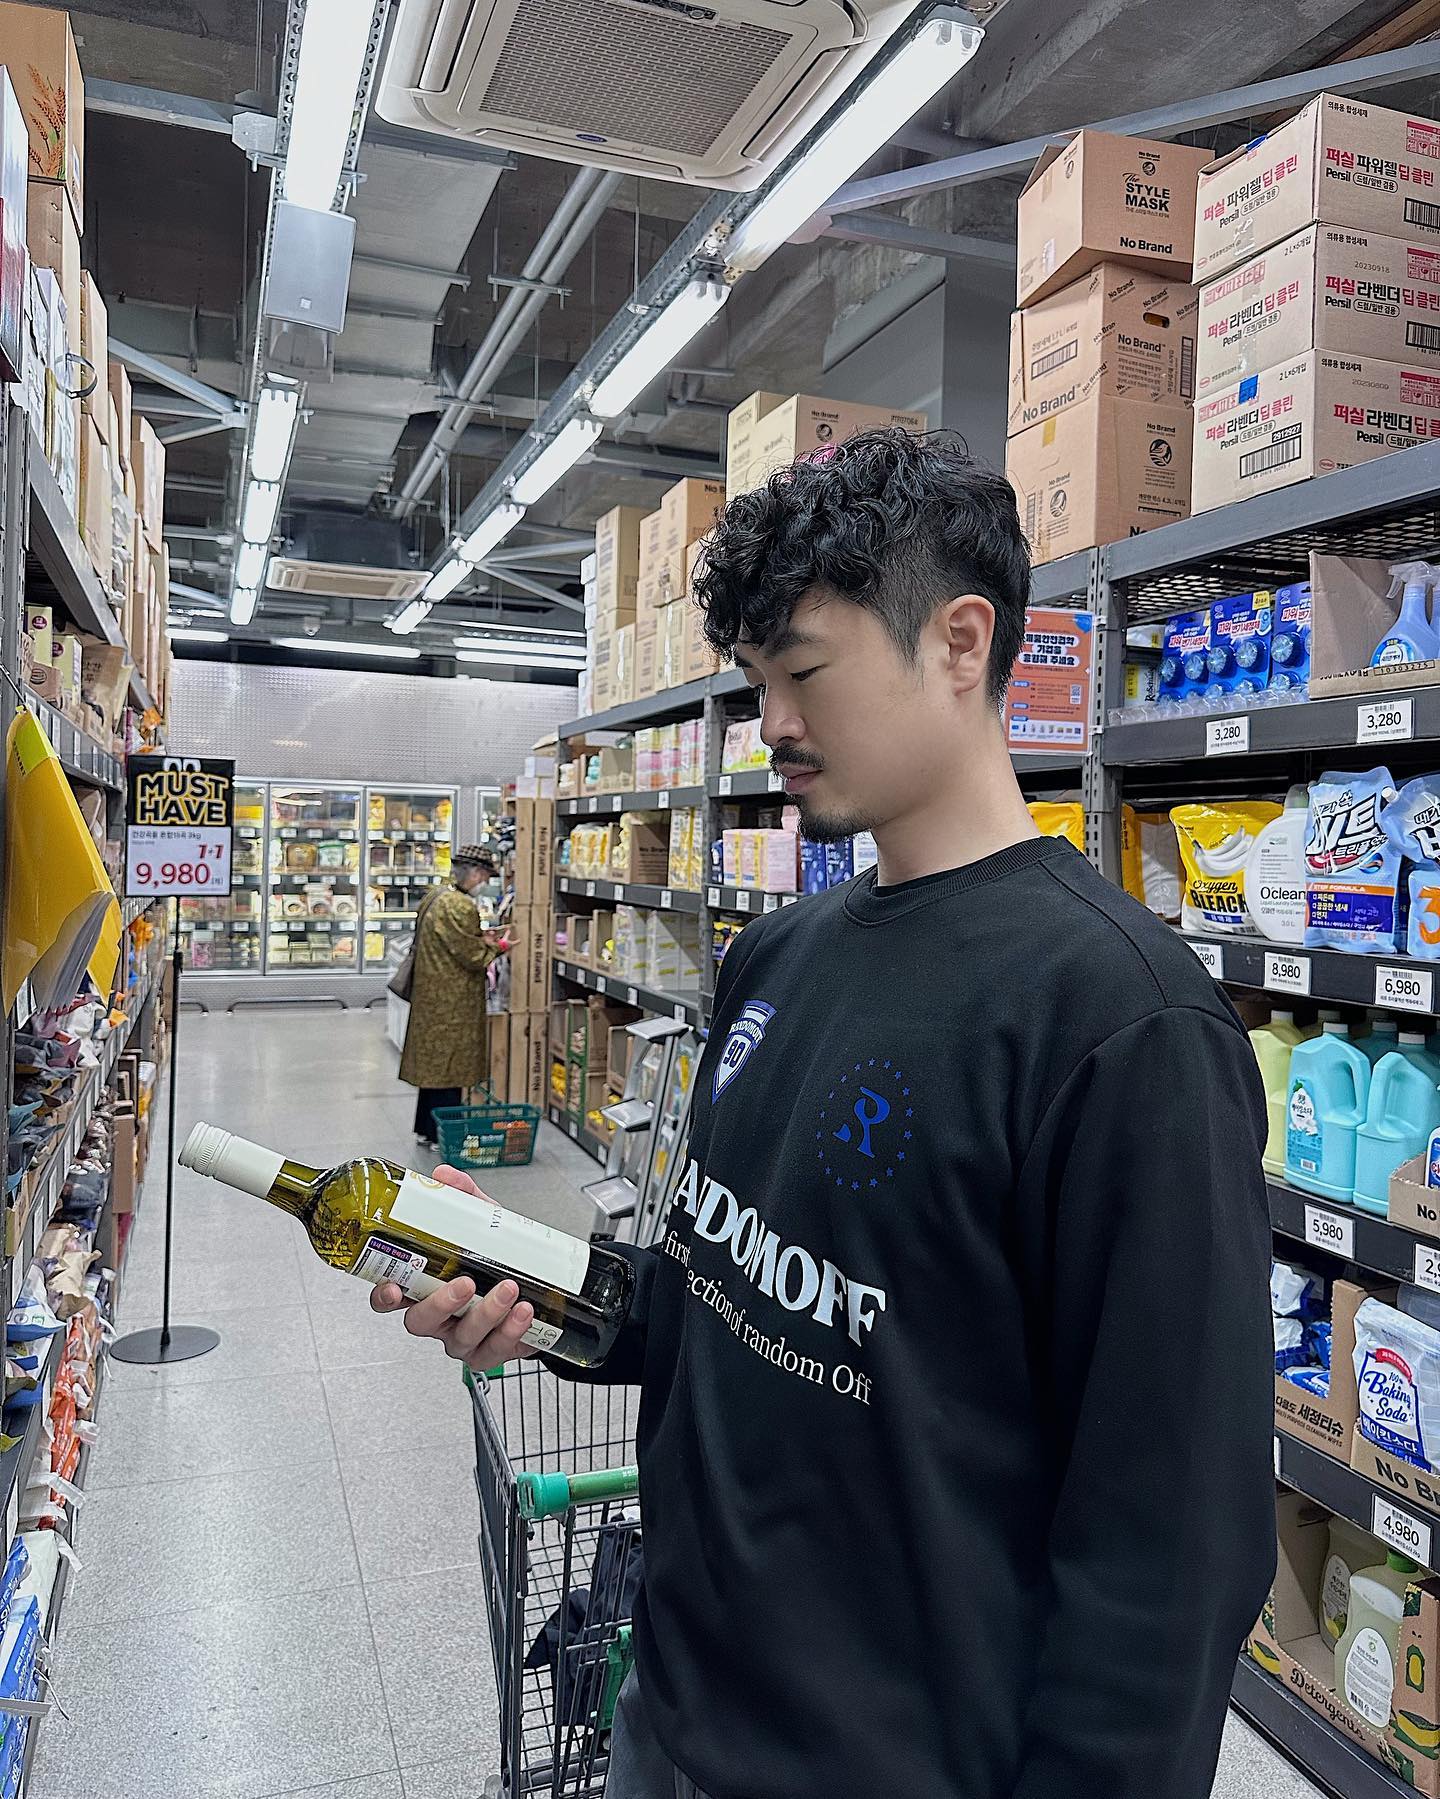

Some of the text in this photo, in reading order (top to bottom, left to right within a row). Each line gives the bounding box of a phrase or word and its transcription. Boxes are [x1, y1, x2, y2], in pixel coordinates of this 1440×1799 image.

[1328, 101, 1345, 113] 의류용
[1326, 147, 1434, 187] 퍼실 파워젤 딥 클린
[1326, 167, 1351, 182] Persil
[1122, 172, 1141, 184] The
[1126, 183, 1170, 199] STYLE
[1204, 154, 1298, 221] 퍼실 파워젤 딥 클린
[1126, 194, 1170, 212] MASK
[1219, 209, 1240, 228] Persil
[1120, 237, 1172, 254] No Brand
[1354, 261, 1390, 274] 20230918
[1108, 280, 1134, 299] No Brand
[1326, 276, 1440, 312] 퍼실 라벤더 딥 클린
[1142, 290, 1168, 308] No Brand
[1325, 296, 1352, 309] Persil
[1208, 281, 1299, 338] 퍼실 라벤더 딥 클린
[1118, 334, 1162, 352] No Brand
[1223, 330, 1242, 347] Persil
[1022, 386, 1076, 424] No Brand
[1206, 394, 1294, 441] 퍼실 라벤더 딥 클린
[1334, 404, 1427, 436] 퍼실 라벤더 딥
[1147, 422, 1176, 434] No Brand
[1356, 430, 1384, 444] Persil
[1220, 435, 1238, 450] Persil
[704, 484, 717, 492] No
[1367, 712, 1402, 730] 3,280
[1214, 725, 1241, 742] 3,280
[139, 773, 227, 799] MUST
[139, 799, 226, 823] HAVE
[136, 862, 211, 889] 9,980
[1192, 880, 1238, 894] Oxygen
[1272, 962, 1301, 979] 8,980
[1384, 978, 1421, 996] 6,980
[723, 1040, 746, 1068] 90
[1417, 1204, 1437, 1222] No
[1312, 1219, 1344, 1241] 5,980
[664, 1230, 873, 1406] first of random Off
[1363, 1370, 1411, 1409] Baking
[1276, 1396, 1344, 1437] 다용도 세정티슈
[1376, 1397, 1408, 1422] Soda
[1375, 1456, 1408, 1488] No
[1383, 1515, 1420, 1546] 4,980
